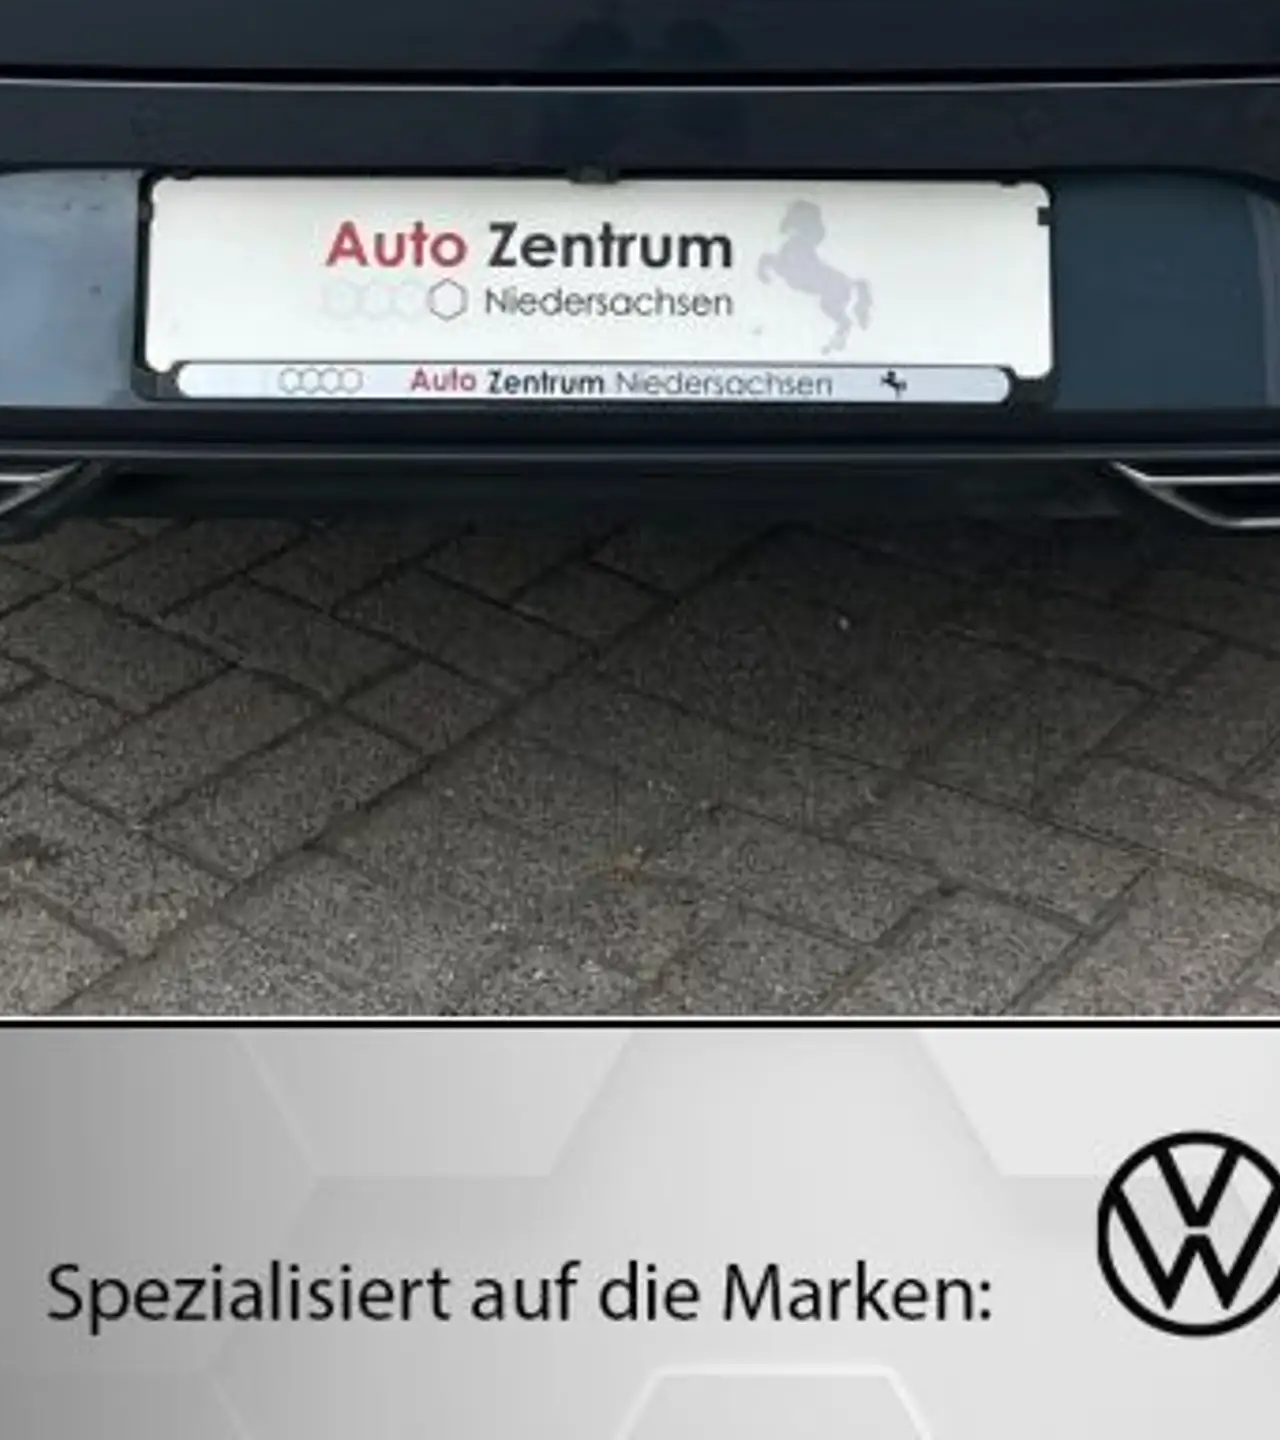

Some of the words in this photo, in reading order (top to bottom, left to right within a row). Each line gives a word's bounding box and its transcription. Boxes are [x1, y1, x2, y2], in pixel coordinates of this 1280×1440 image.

[325, 221, 469, 268] Auto
[487, 221, 735, 269] Zentrum
[483, 285, 734, 319] Niedersachsen
[409, 367, 477, 394] Auto
[487, 369, 606, 396] Zentrum
[615, 371, 833, 397] Niedersachsen
